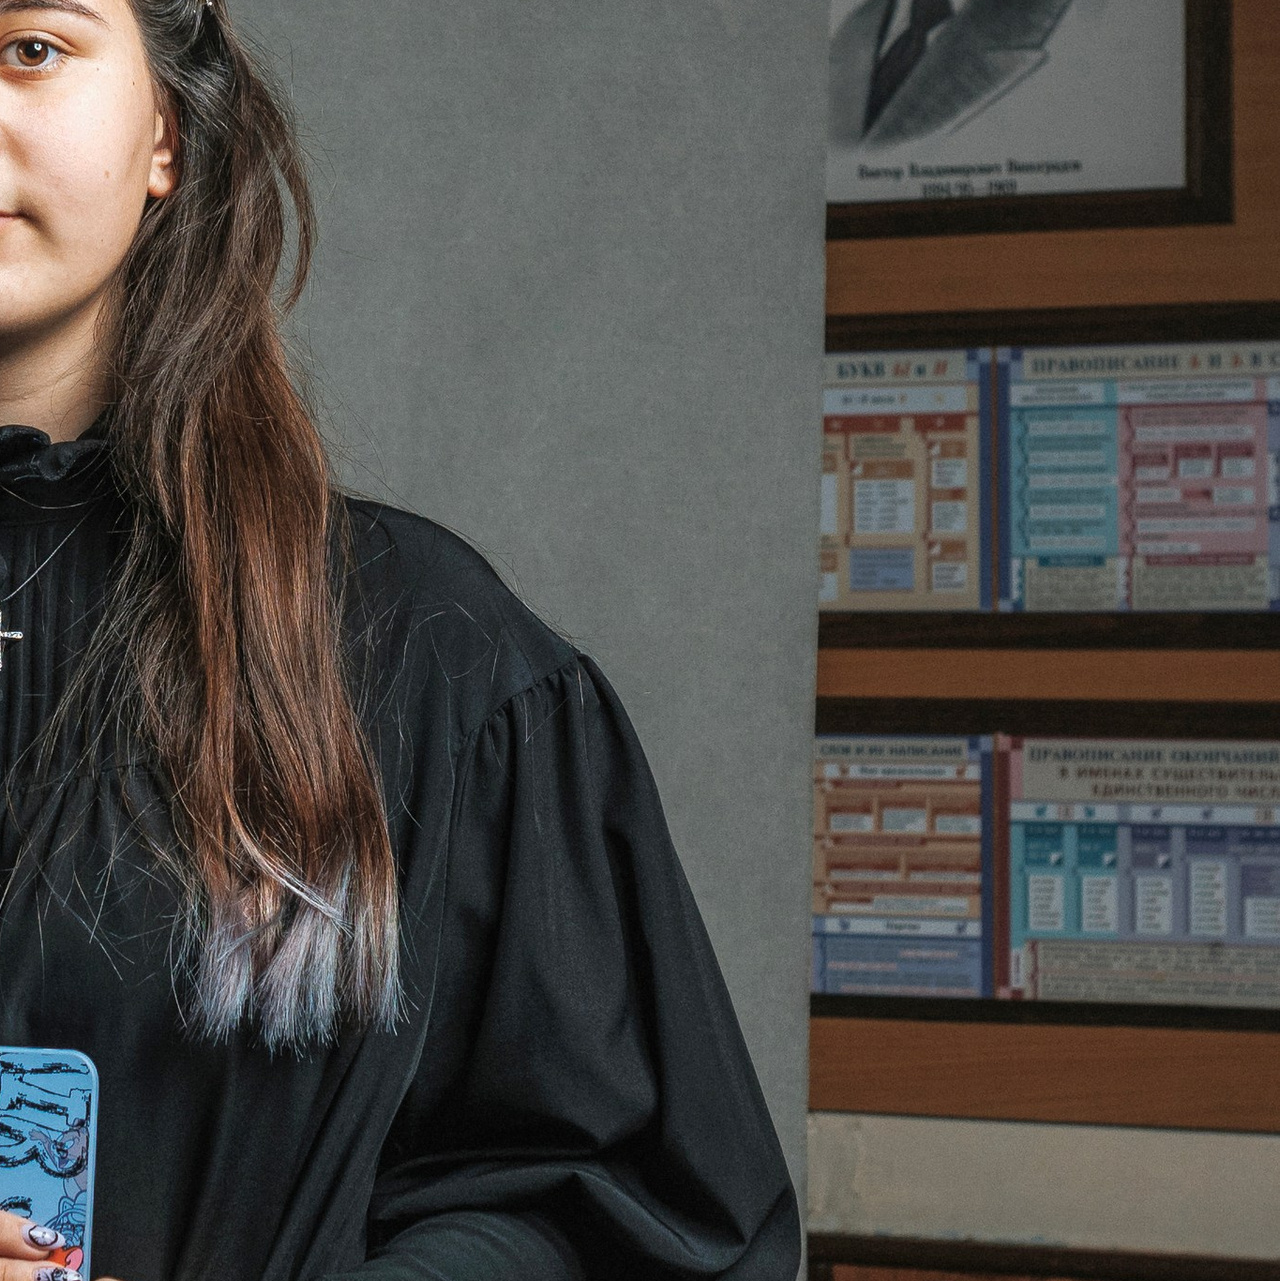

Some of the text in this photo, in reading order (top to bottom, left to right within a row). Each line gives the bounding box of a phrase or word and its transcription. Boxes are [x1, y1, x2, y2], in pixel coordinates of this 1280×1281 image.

[837, 360, 885, 379] БУКВ
[1031, 353, 1180, 374] ПРАВОПИСАНИЕ
[889, 745, 963, 757] НАПИСАНИЕ
[1029, 747, 1280, 764] ПРАВОПИСАНИЕ ОКОНЧАНИЙ
[1076, 767, 1144, 780] ИМЕНАХ
[1091, 784, 1228, 798] ЕДИНСТВЕННОГО
